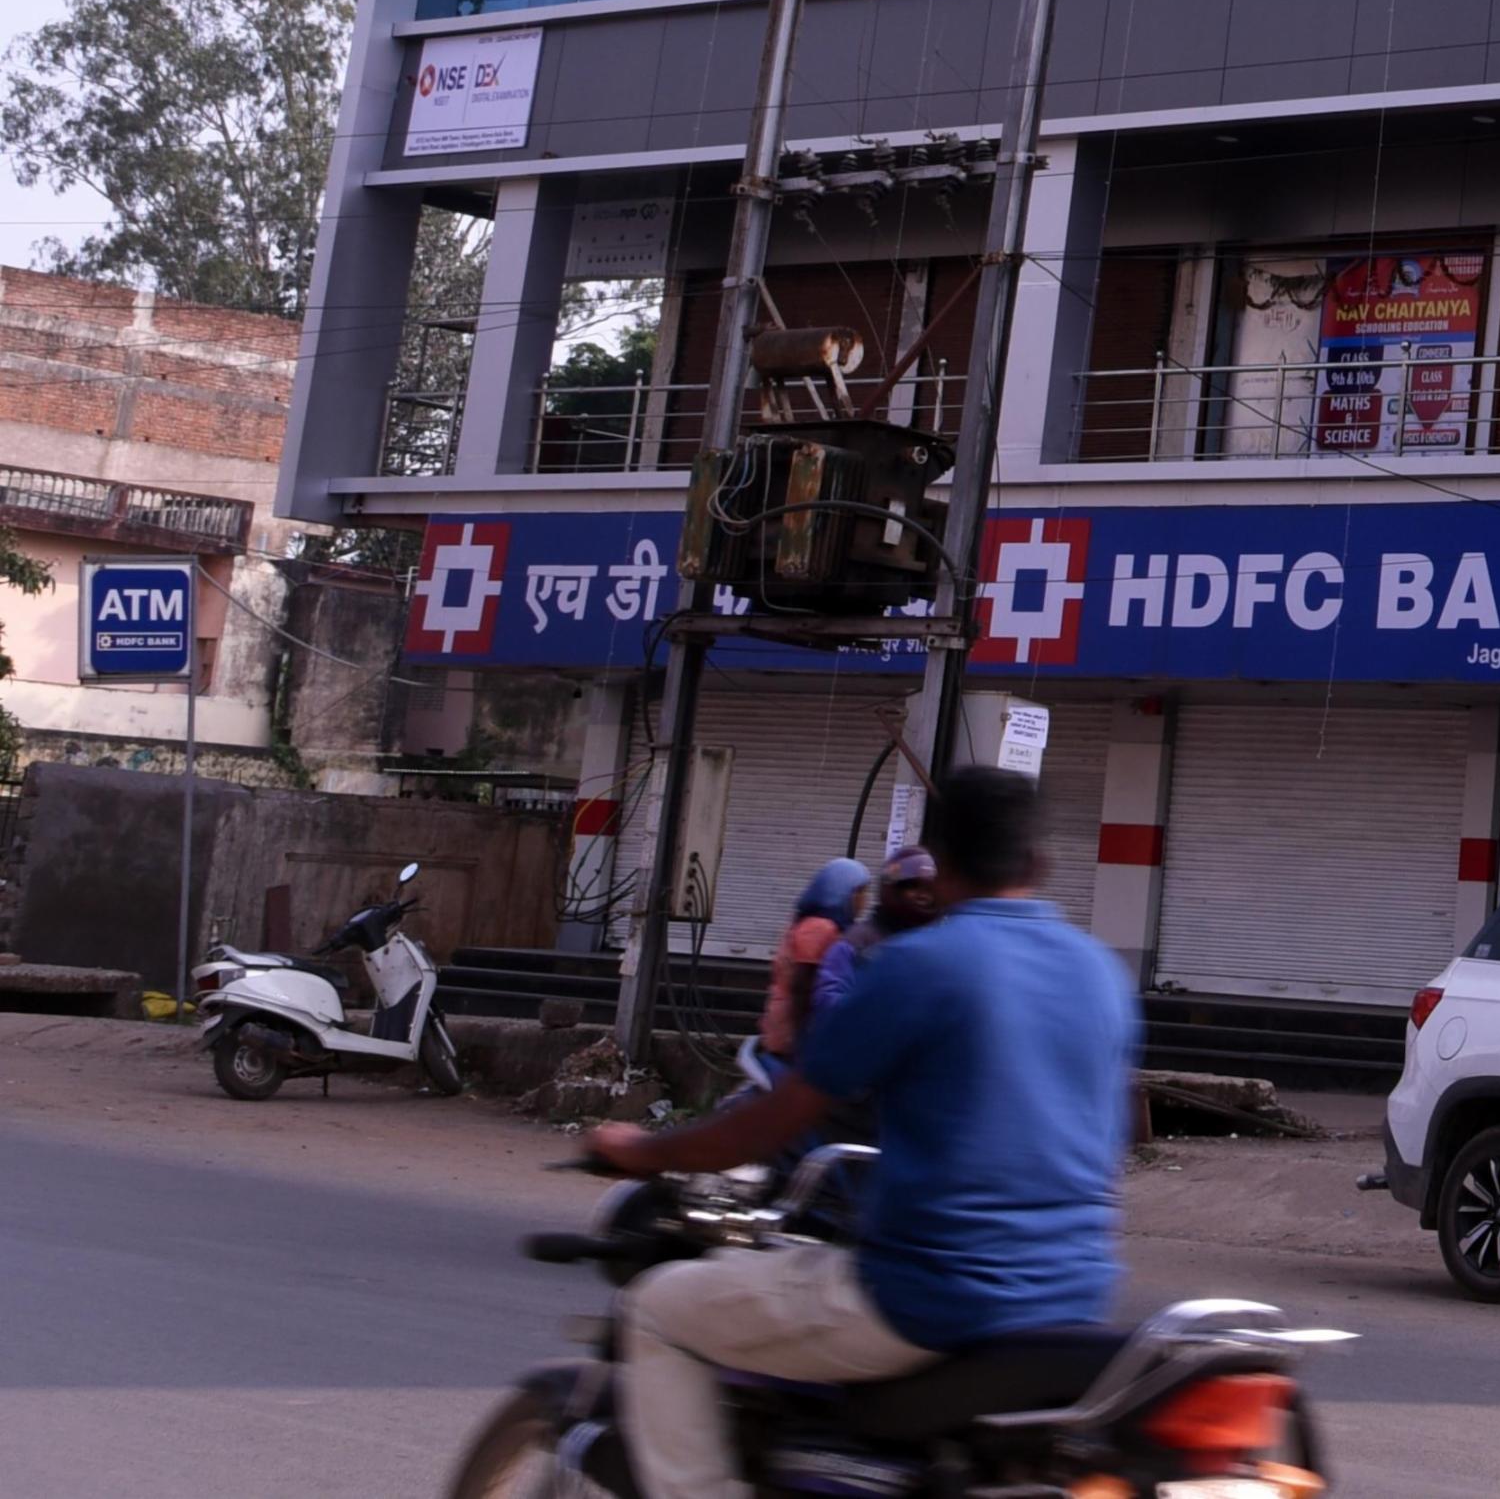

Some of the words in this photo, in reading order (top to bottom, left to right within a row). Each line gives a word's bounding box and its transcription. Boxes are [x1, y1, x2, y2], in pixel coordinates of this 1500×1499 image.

[437, 65, 467, 91] NSE
[1374, 299, 1471, 320] CHAITANYA
[1403, 320, 1449, 332] EDUCATION
[1421, 370, 1443, 383] CLASS
[1329, 396, 1371, 411] MATHS
[1324, 429, 1372, 444] SCIENCE
[525, 565, 598, 634] एच
[605, 538, 668, 621] डी
[1108, 551, 1345, 631] HDFC
[98, 589, 183, 621] ATM
[116, 637, 144, 646] HDFC
[146, 637, 177, 646] BANK
